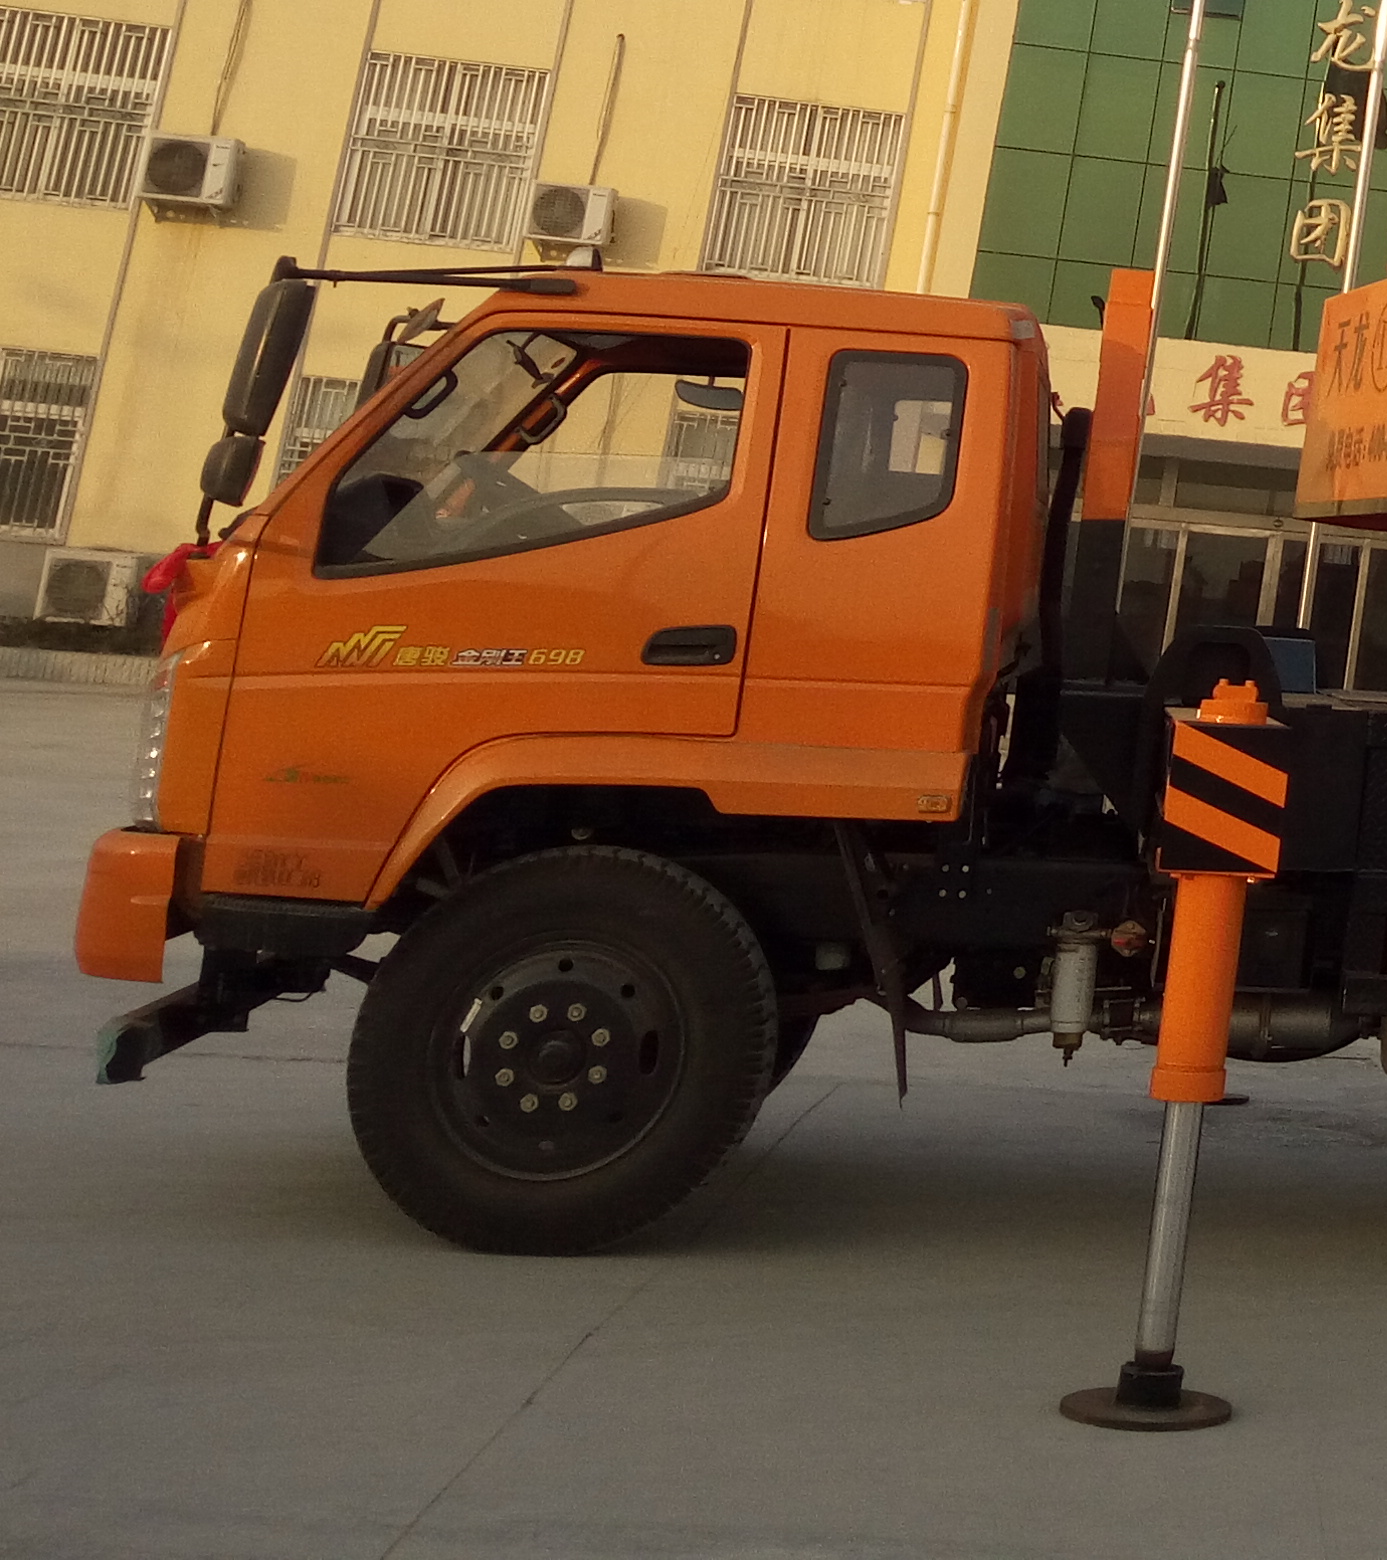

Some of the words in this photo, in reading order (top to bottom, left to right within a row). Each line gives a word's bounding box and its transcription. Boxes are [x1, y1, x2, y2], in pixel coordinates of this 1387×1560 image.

[1326, 311, 1370, 397] 天龙
[394, 647, 449, 666] 唐骏
[528, 649, 586, 665] 698
